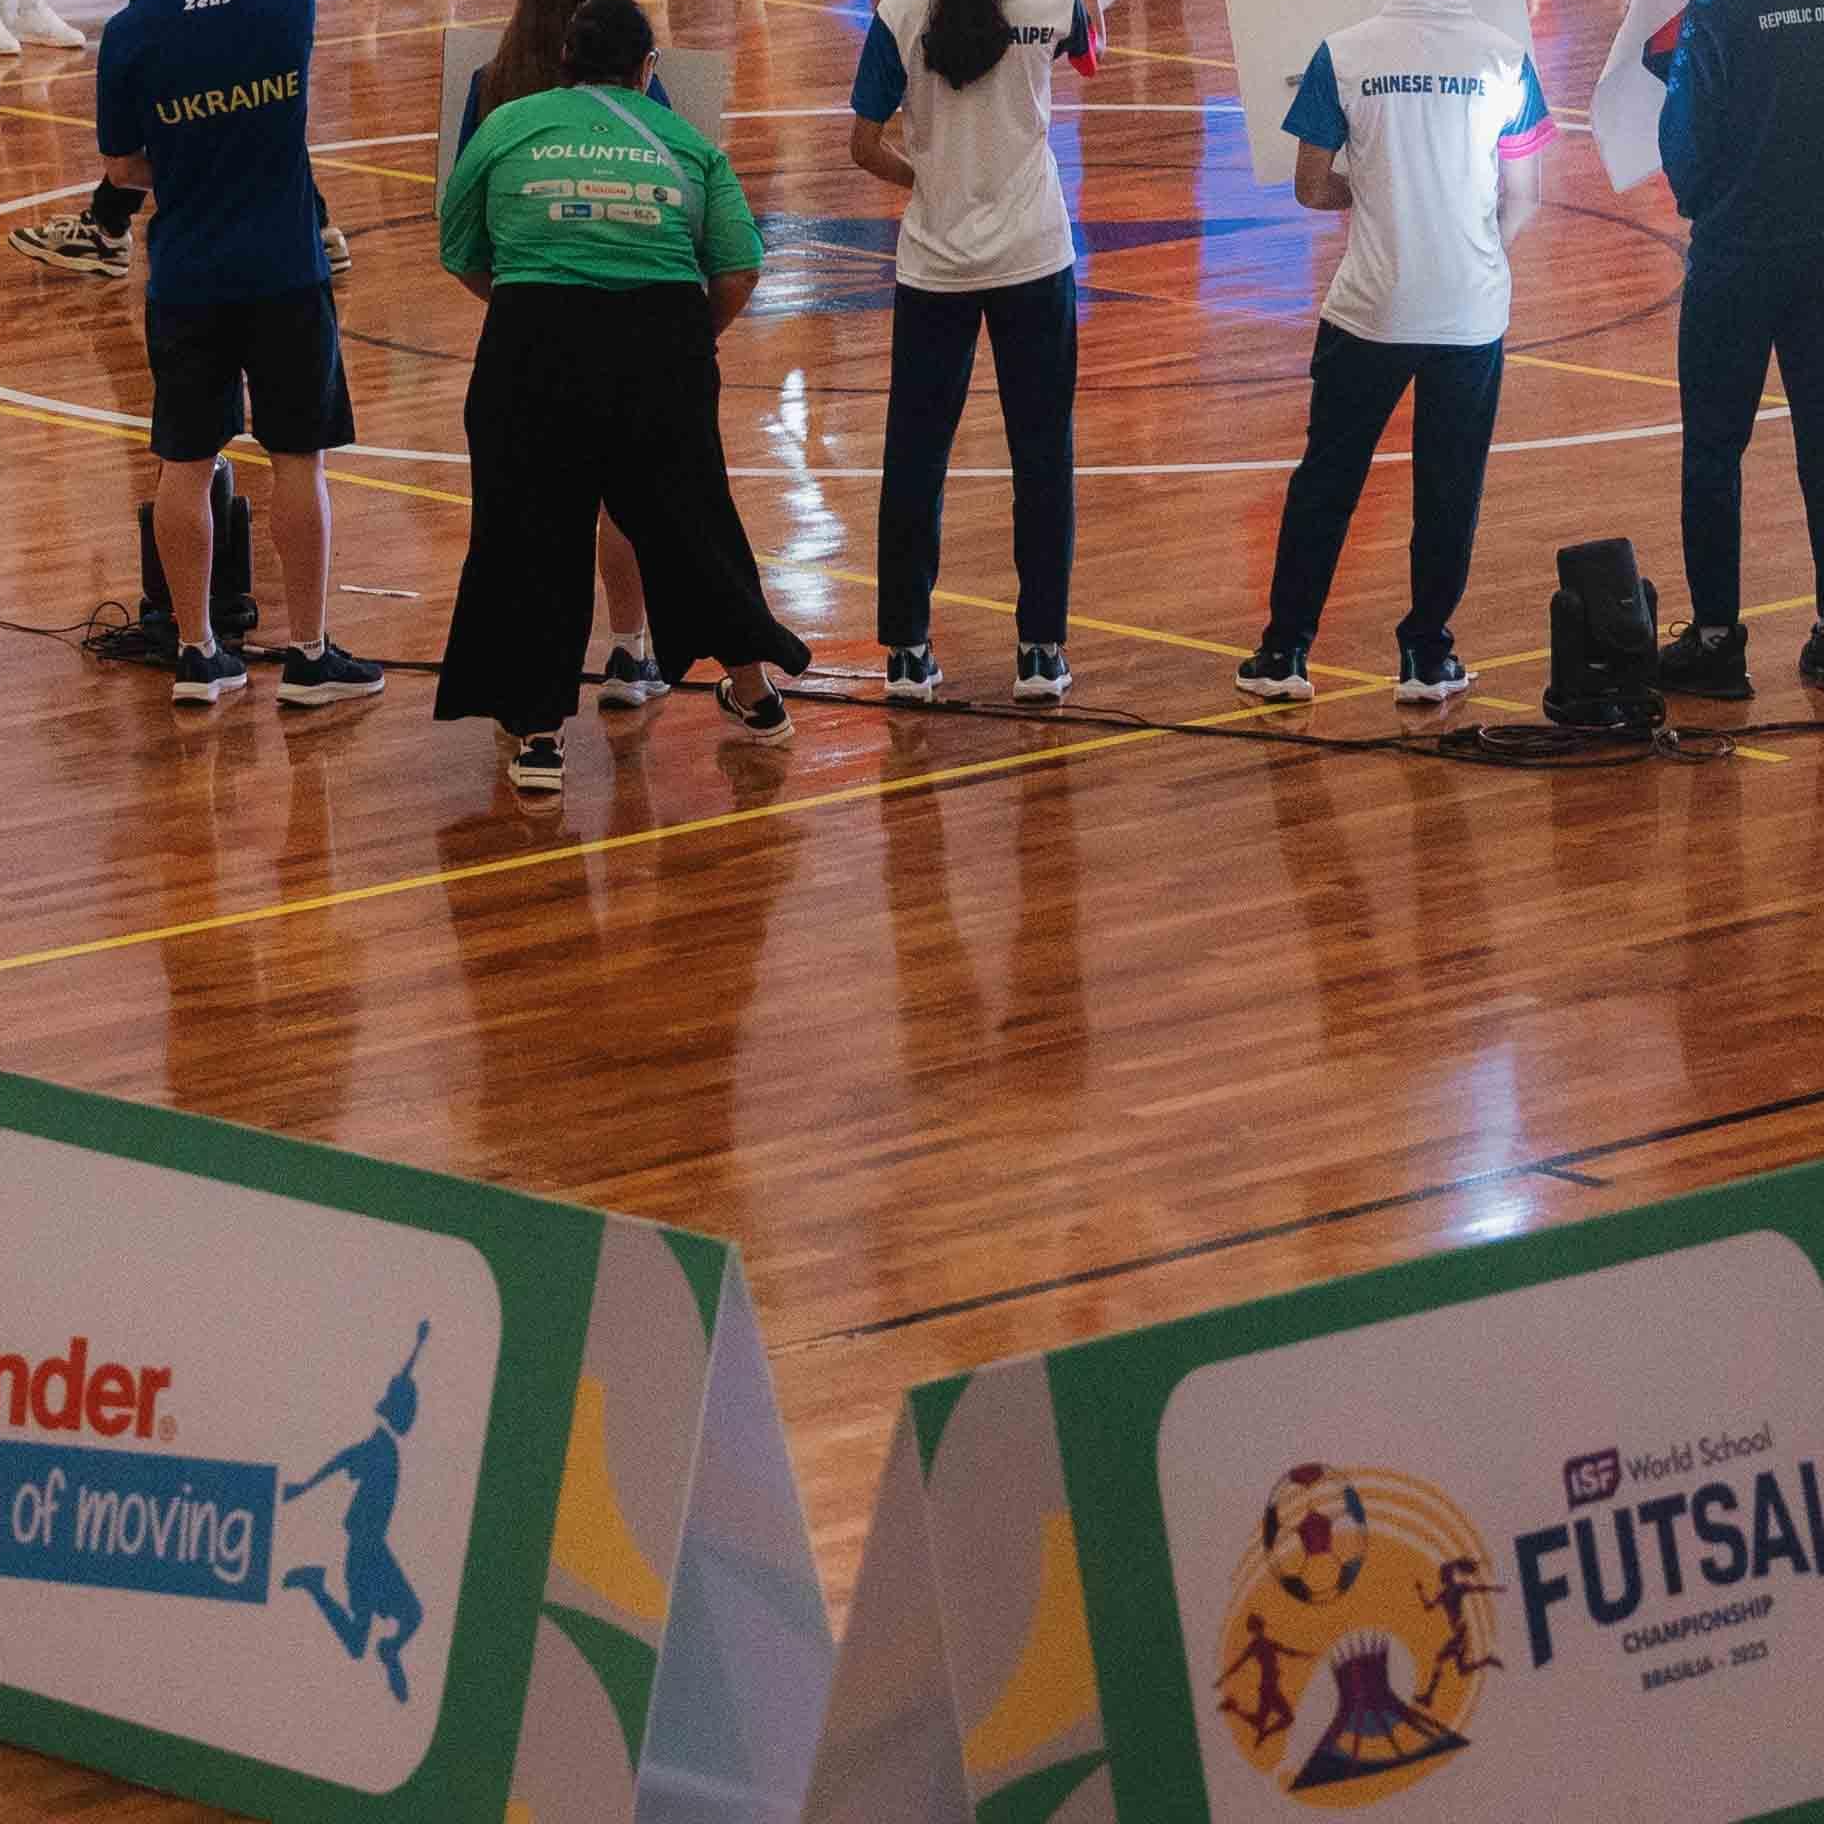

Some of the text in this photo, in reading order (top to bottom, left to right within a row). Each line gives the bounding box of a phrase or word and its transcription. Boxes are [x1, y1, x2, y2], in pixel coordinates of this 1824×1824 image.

[1758, 7, 1814, 31] REPUBLIC
[156, 69, 300, 125] UKRAINE
[1361, 74, 1433, 96] CHINESE
[1626, 1442, 1694, 1482] World
[1697, 1423, 1774, 1467] School
[12, 1467, 66, 1546] of
[75, 1484, 256, 1585] moving
[1622, 1594, 1775, 1655] CHAMPIONSHIP
